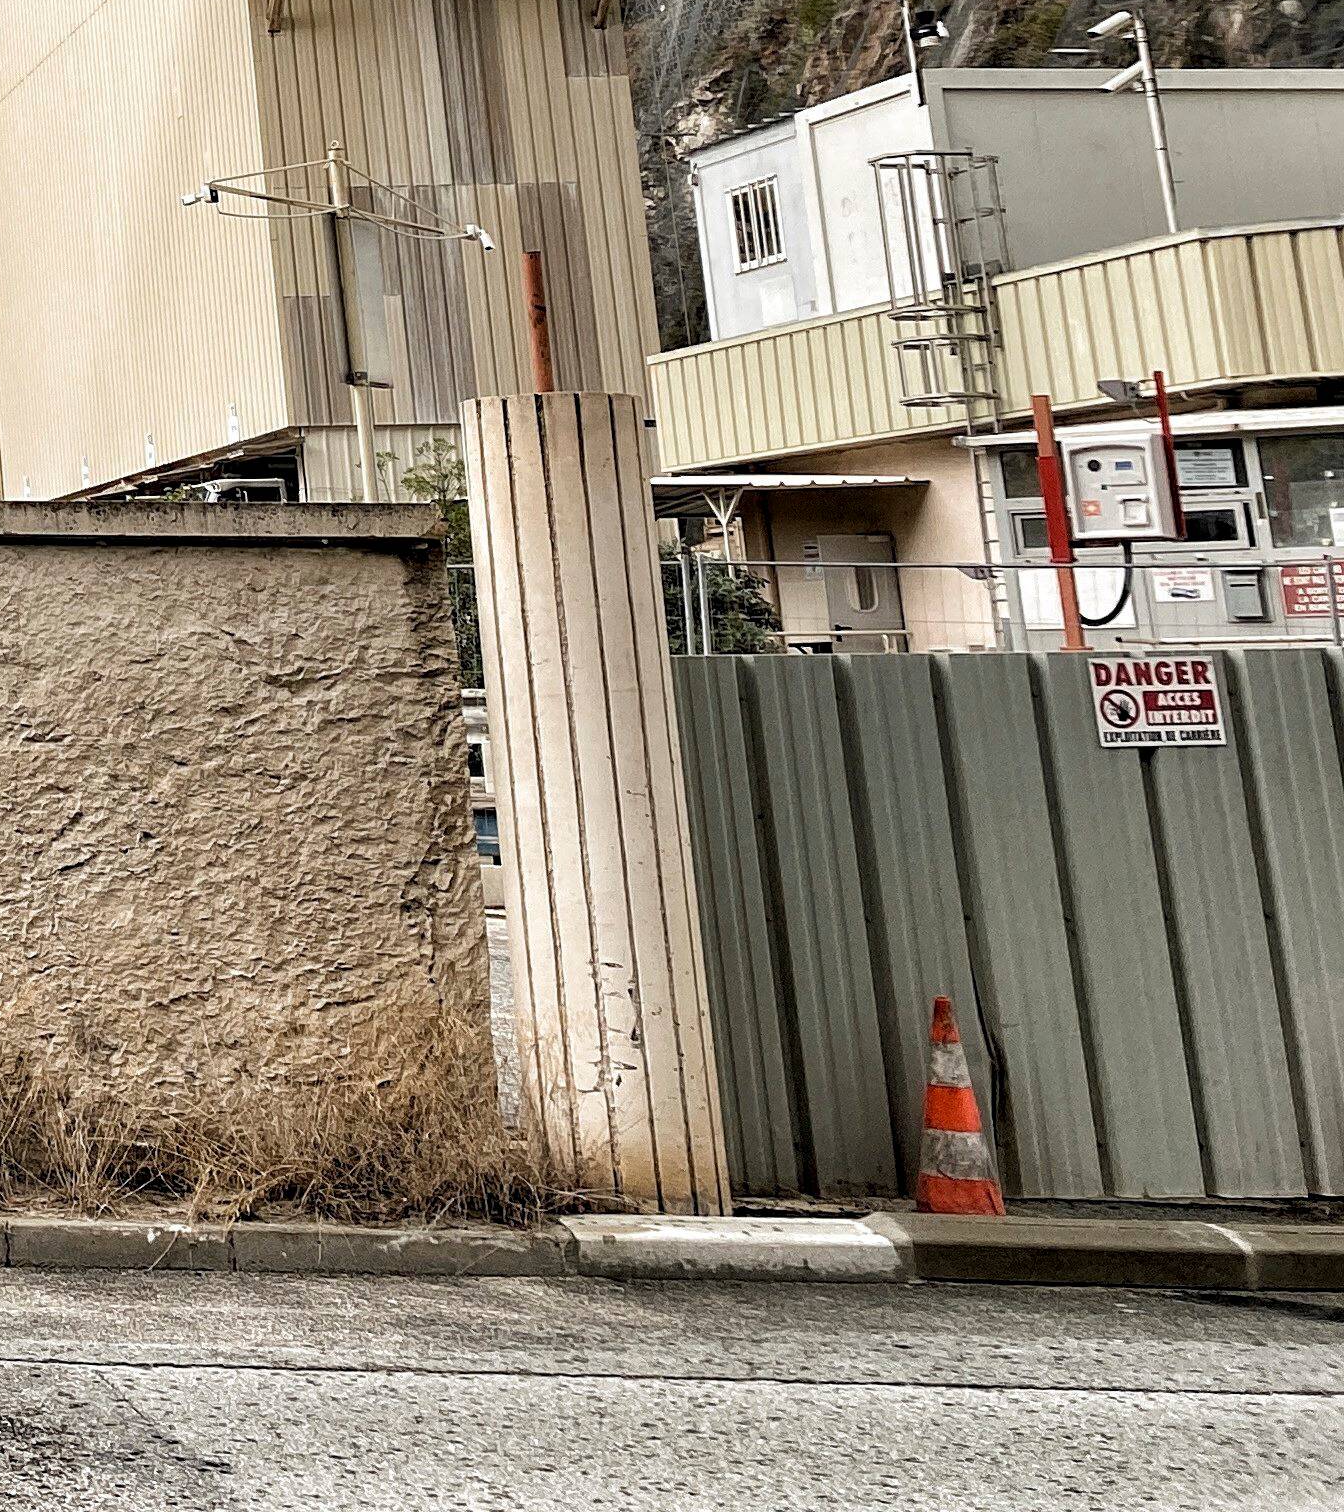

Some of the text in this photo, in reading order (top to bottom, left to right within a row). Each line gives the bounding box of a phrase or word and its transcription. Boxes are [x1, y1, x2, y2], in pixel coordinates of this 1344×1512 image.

[1093, 661, 1212, 686] DANGER
[1158, 692, 1201, 707] ACCES
[1148, 710, 1214, 724] INTERDIT
